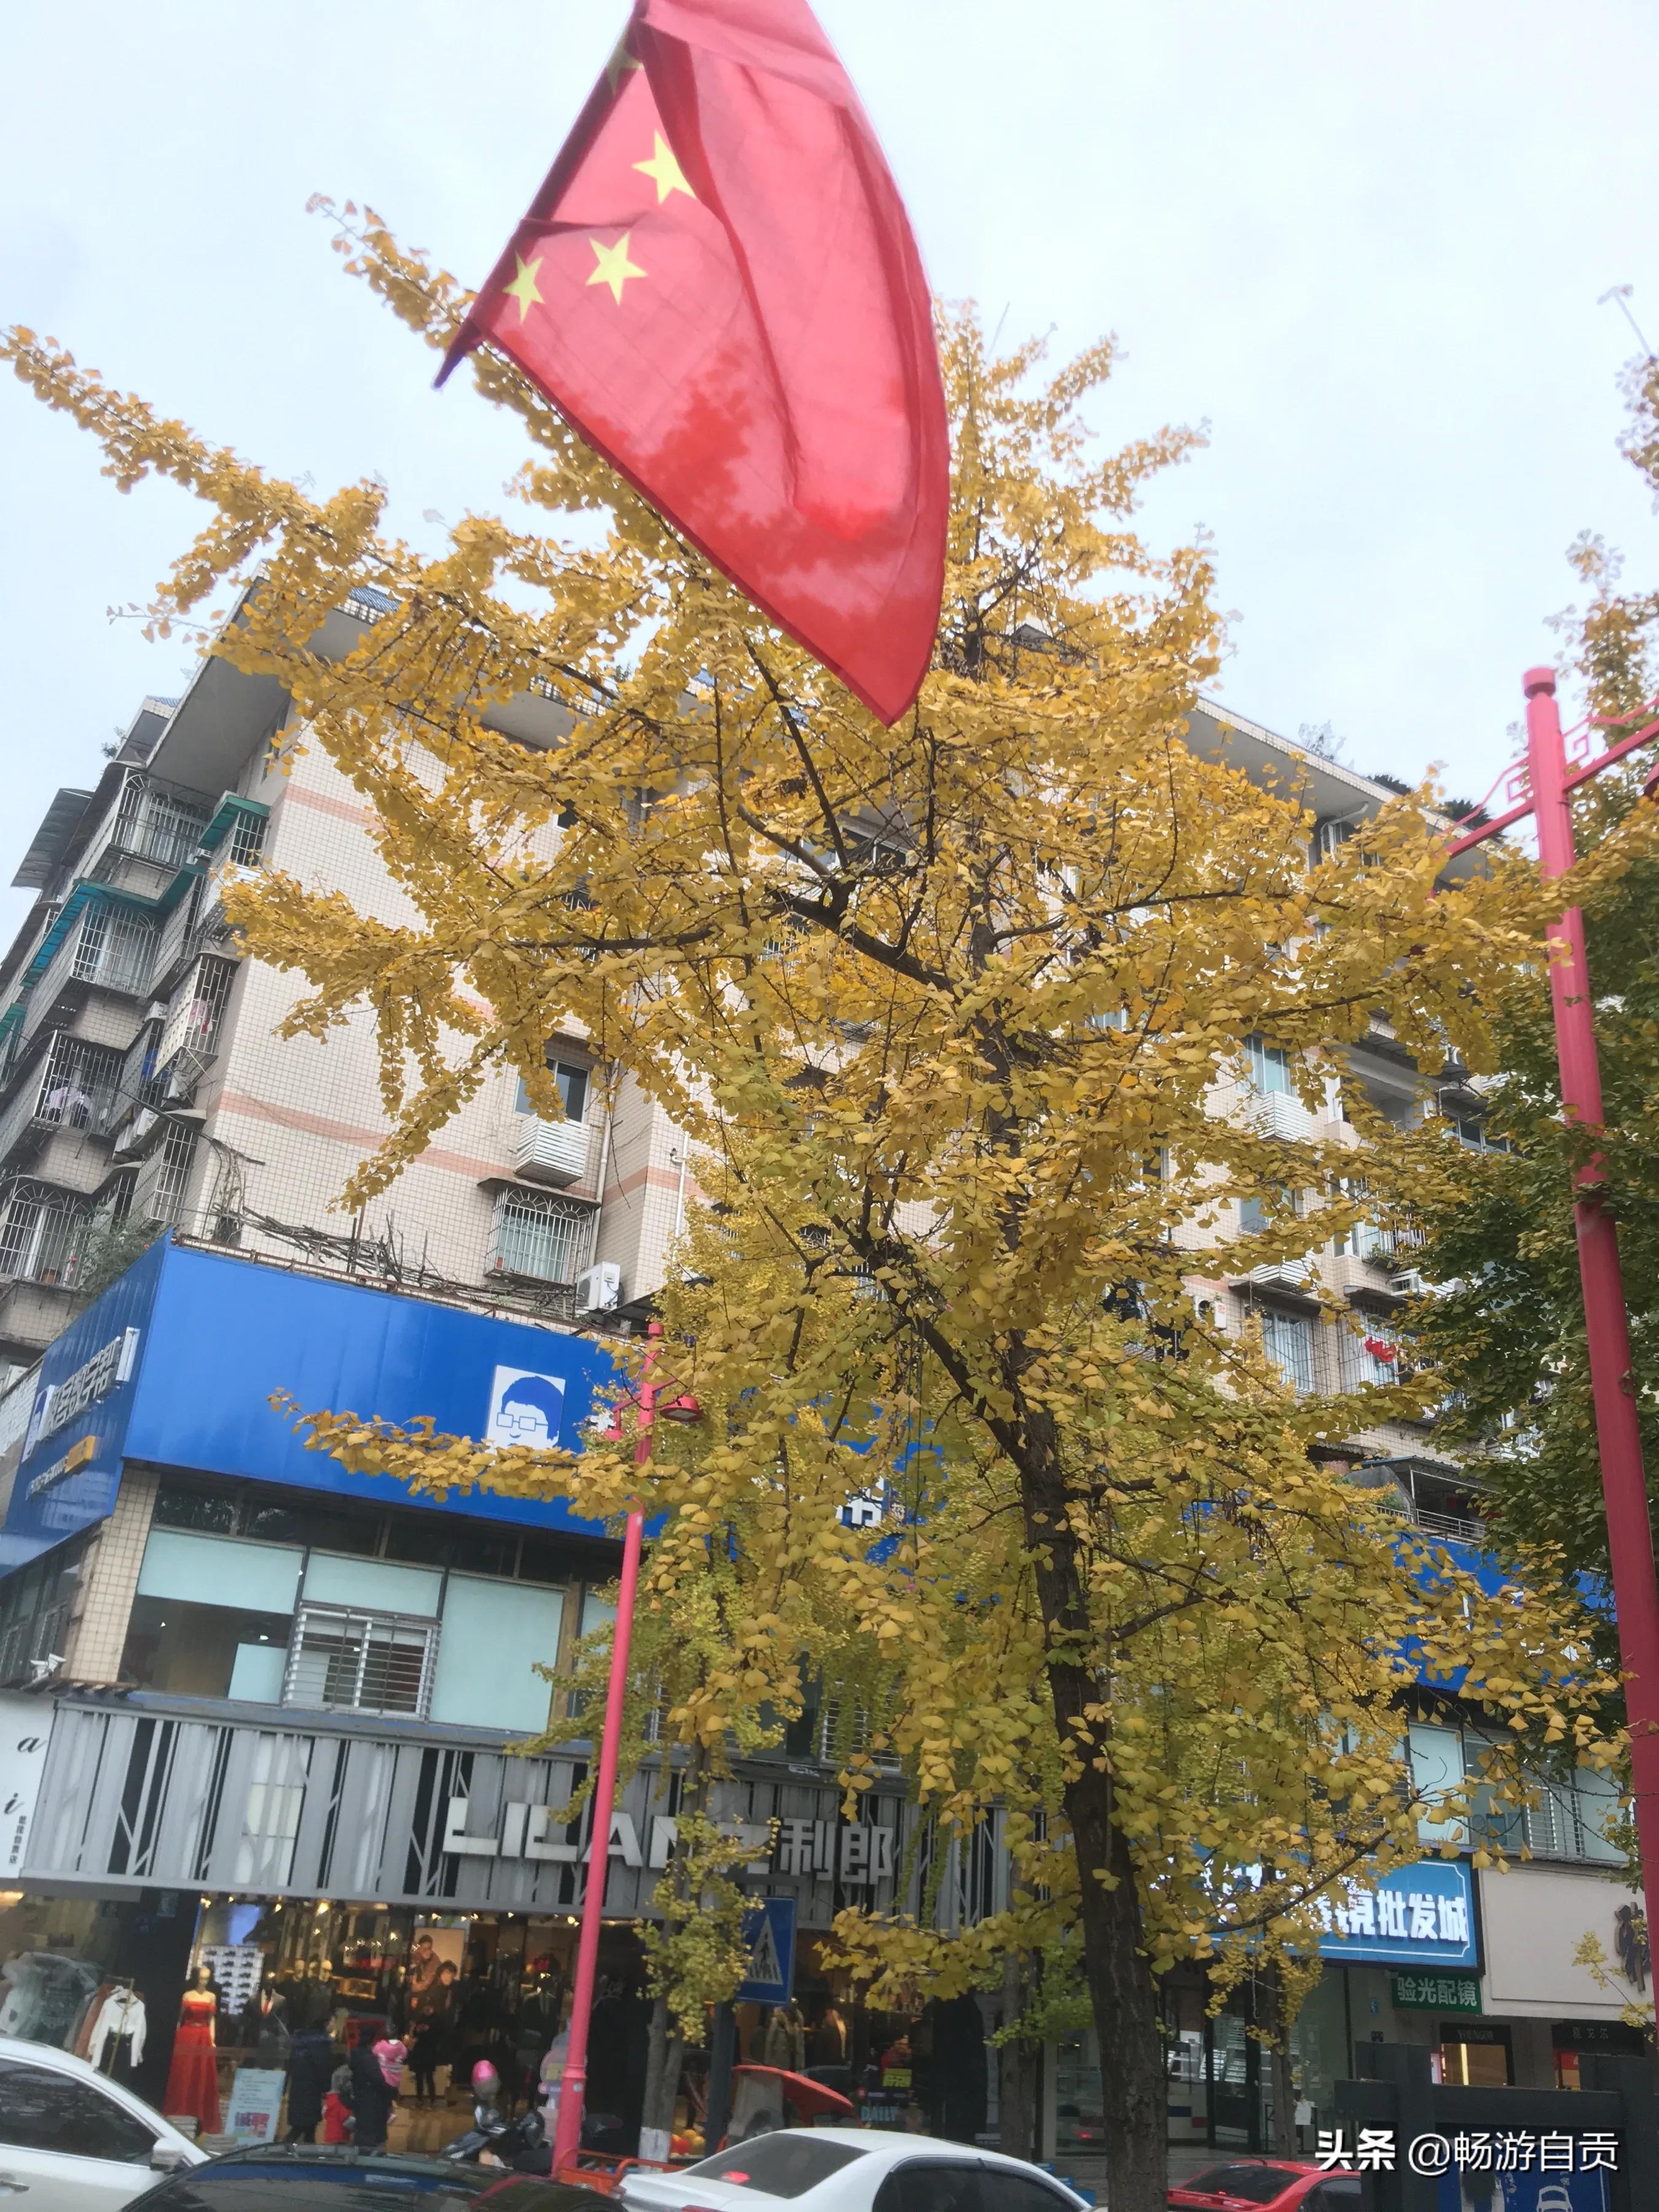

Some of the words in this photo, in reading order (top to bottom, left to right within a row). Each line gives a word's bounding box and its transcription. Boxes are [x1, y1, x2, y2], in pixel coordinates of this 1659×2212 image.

[780, 1817, 893, 1885] 利郎
[1397, 1977, 1477, 2007] 验光配镜
